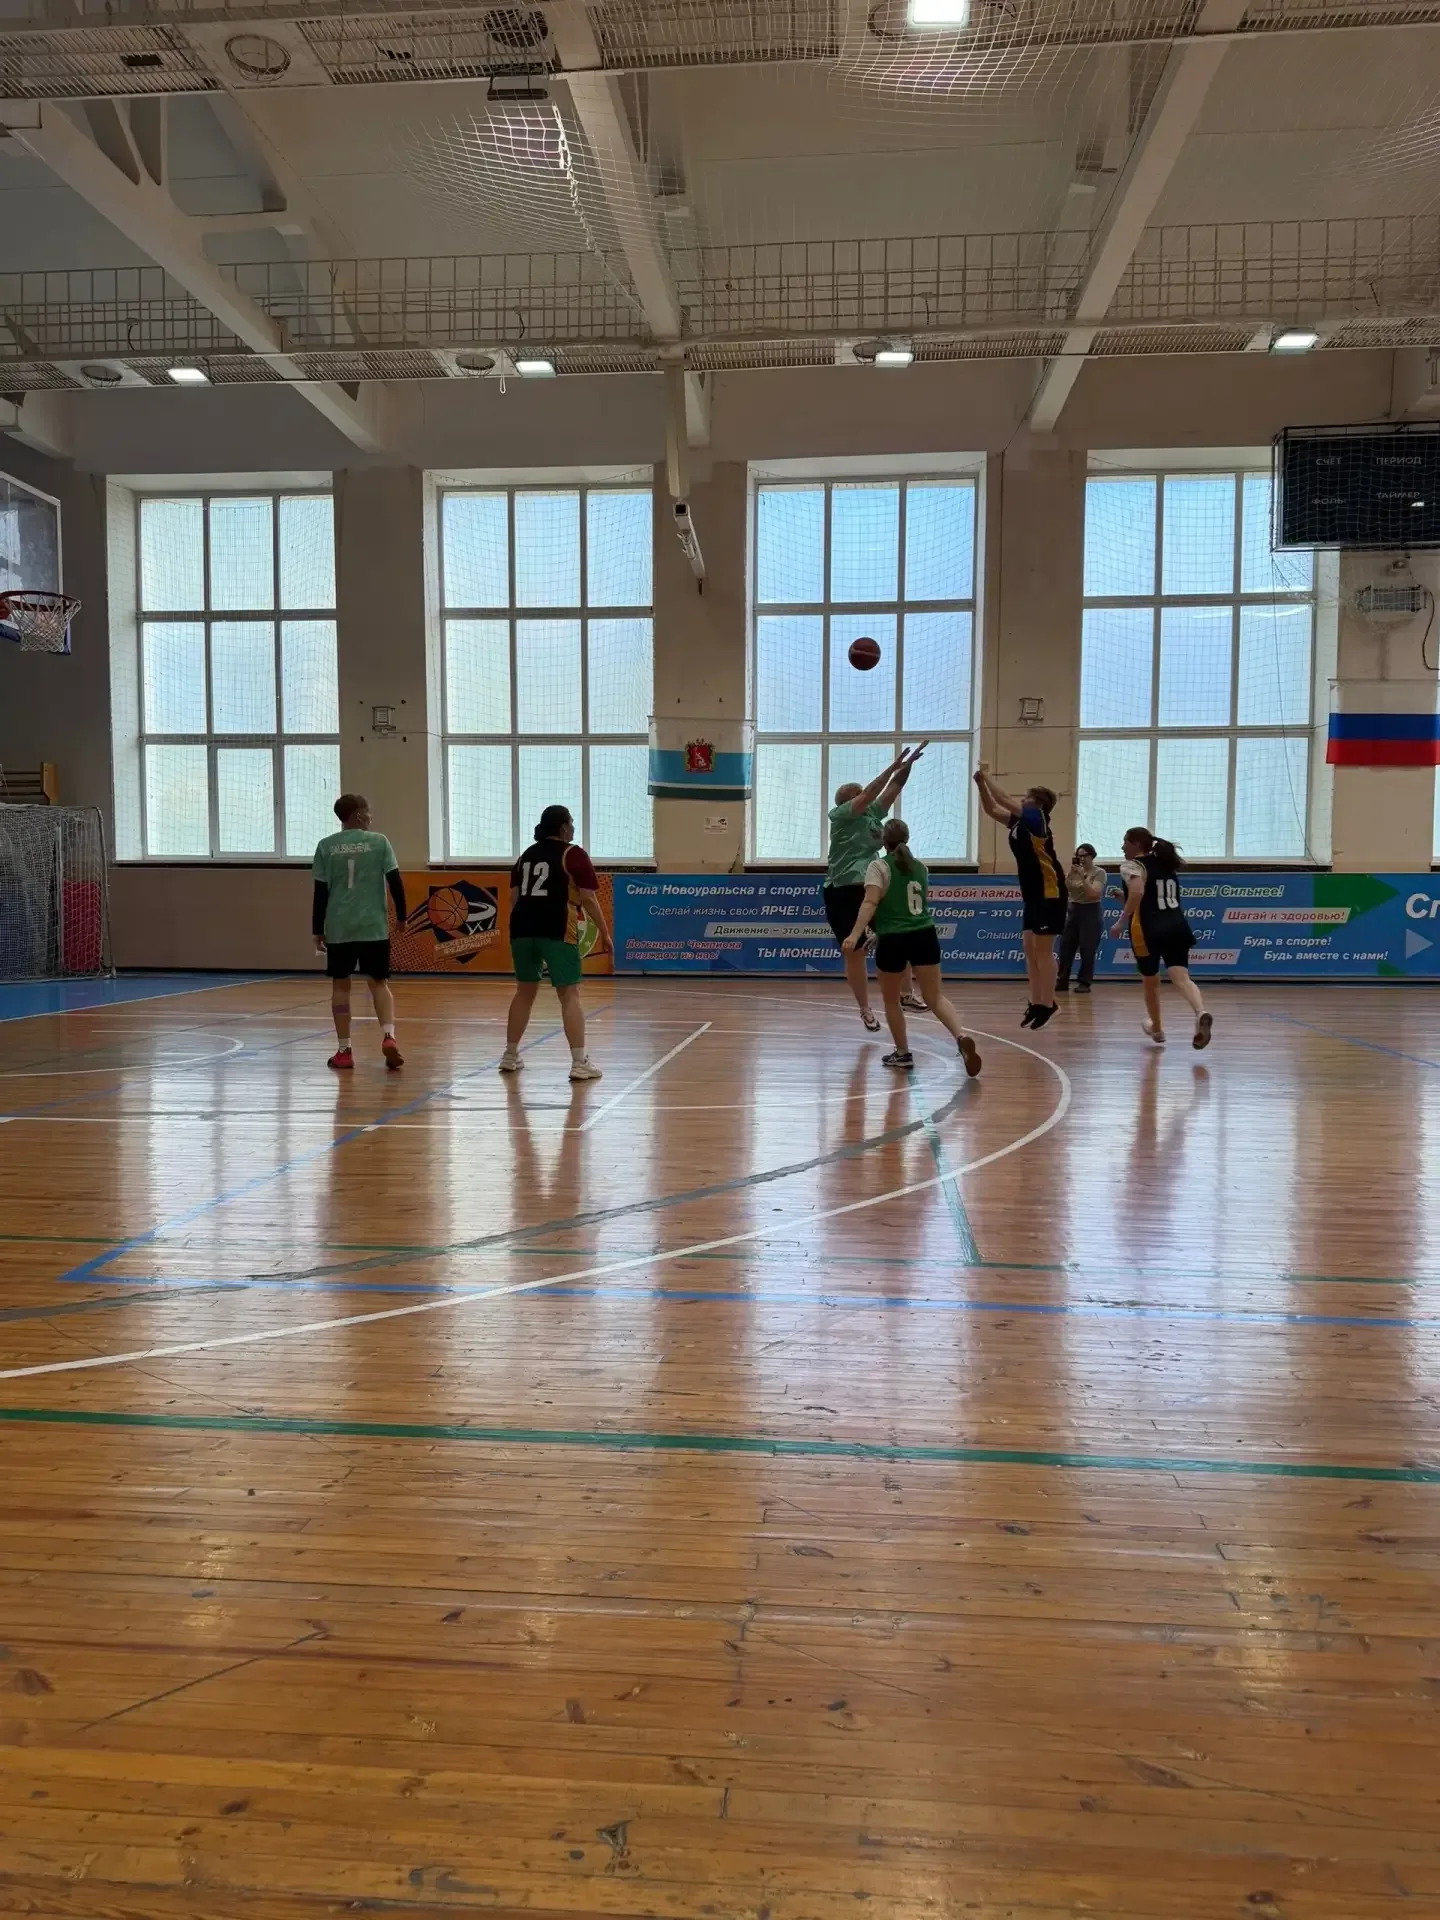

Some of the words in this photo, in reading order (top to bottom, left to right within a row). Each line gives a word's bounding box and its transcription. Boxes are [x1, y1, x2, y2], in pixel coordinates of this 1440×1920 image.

[1375, 456, 1422, 465] ПЕРИОД
[347, 859, 355, 889] 1
[520, 861, 550, 896] 12
[626, 884, 658, 895] Сила
[662, 884, 755, 897] Новоуральска
[758, 887, 767, 895] в
[769, 885, 821, 897] спорте!
[937, 888, 977, 898] собой
[1156, 878, 1179, 911] 10
[1219, 884, 1285, 898] Сильнее!
[906, 880, 923, 916] 6
[648, 904, 691, 917] Сделай
[693, 907, 727, 916] жизнь
[729, 907, 759, 916] свою
[760, 905, 800, 916] ЯРЧЕ!
[928, 907, 976, 918] Победа
[990, 909, 1013, 918] это
[1228, 911, 1268, 920] Шагай
[1280, 912, 1346, 922] здоровью!
[713, 925, 770, 935] Движение
[626, 939, 684, 949] Потенциал
[688, 940, 742, 949] Чемпиона
[1243, 936, 1273, 947] Будь
[1275, 938, 1283, 946] в
[1286, 936, 1332, 948] спорте!
[696, 950, 721, 960] нас!
[757, 948, 777, 958] ТЫ
[779, 947, 842, 958] МОЖЕШЬ
[940, 949, 1005, 961] обеждай!
[1208, 952, 1234, 961] ГТО?
[1264, 951, 1293, 961] Будь
[1296, 952, 1339, 960] вместе
[1352, 951, 1389, 960] нами!
